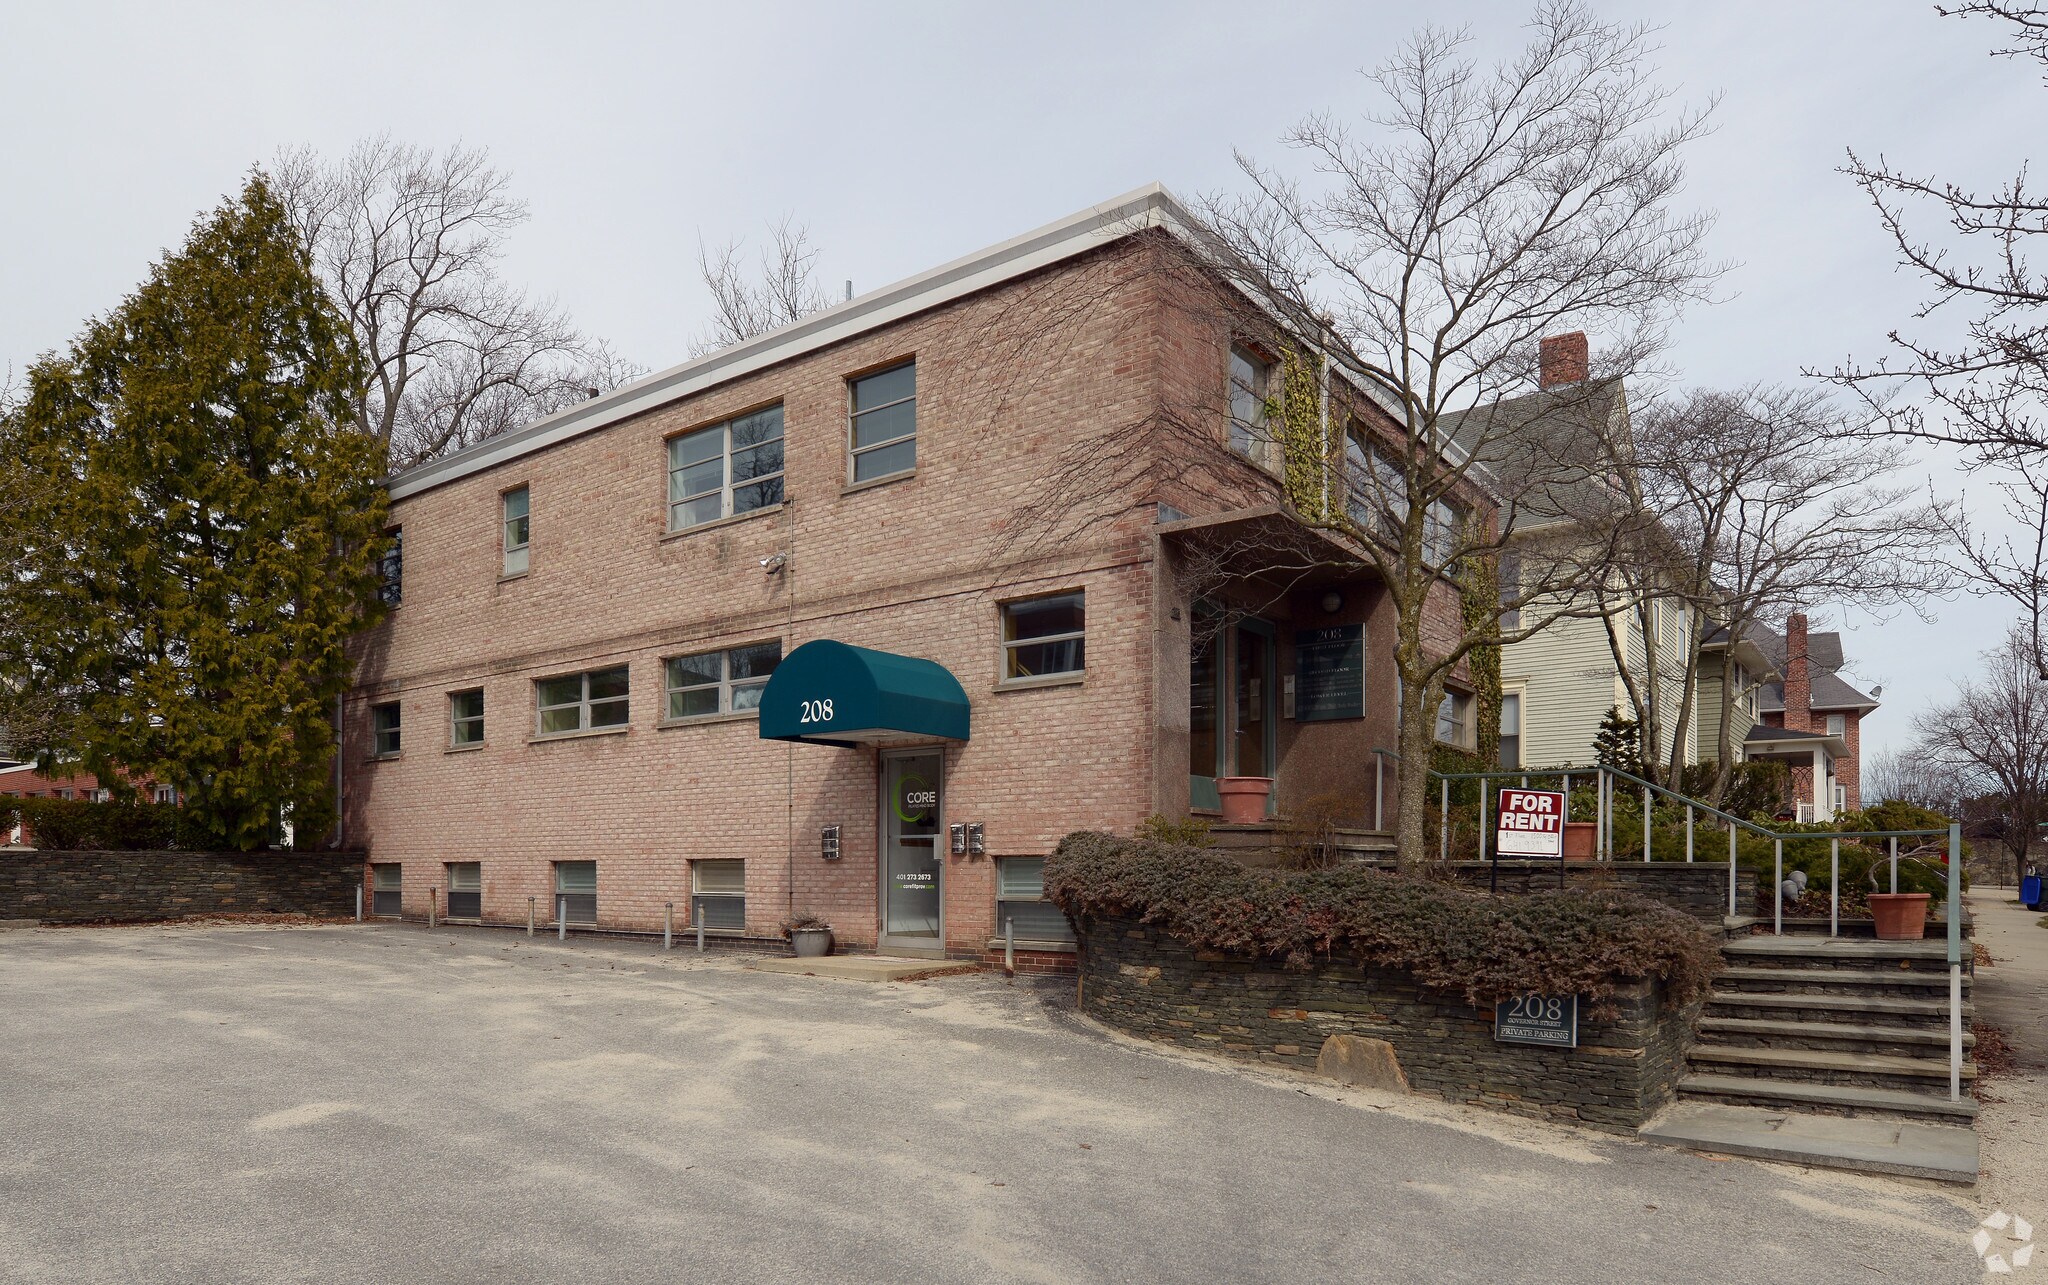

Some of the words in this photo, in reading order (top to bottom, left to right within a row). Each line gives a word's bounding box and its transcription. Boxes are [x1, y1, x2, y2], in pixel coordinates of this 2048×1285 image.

[1316, 628, 1342, 642] 208
[800, 698, 834, 724] 208
[907, 791, 936, 804] CORE
[1509, 794, 1553, 813] FOR
[1500, 812, 1559, 831] RENT
[1508, 995, 1562, 1021] 208
[1507, 1018, 1539, 1026] GOVERNOR
[1501, 1027, 1534, 1037] PRIVATE
[1534, 1030, 1569, 1040] PARKING
